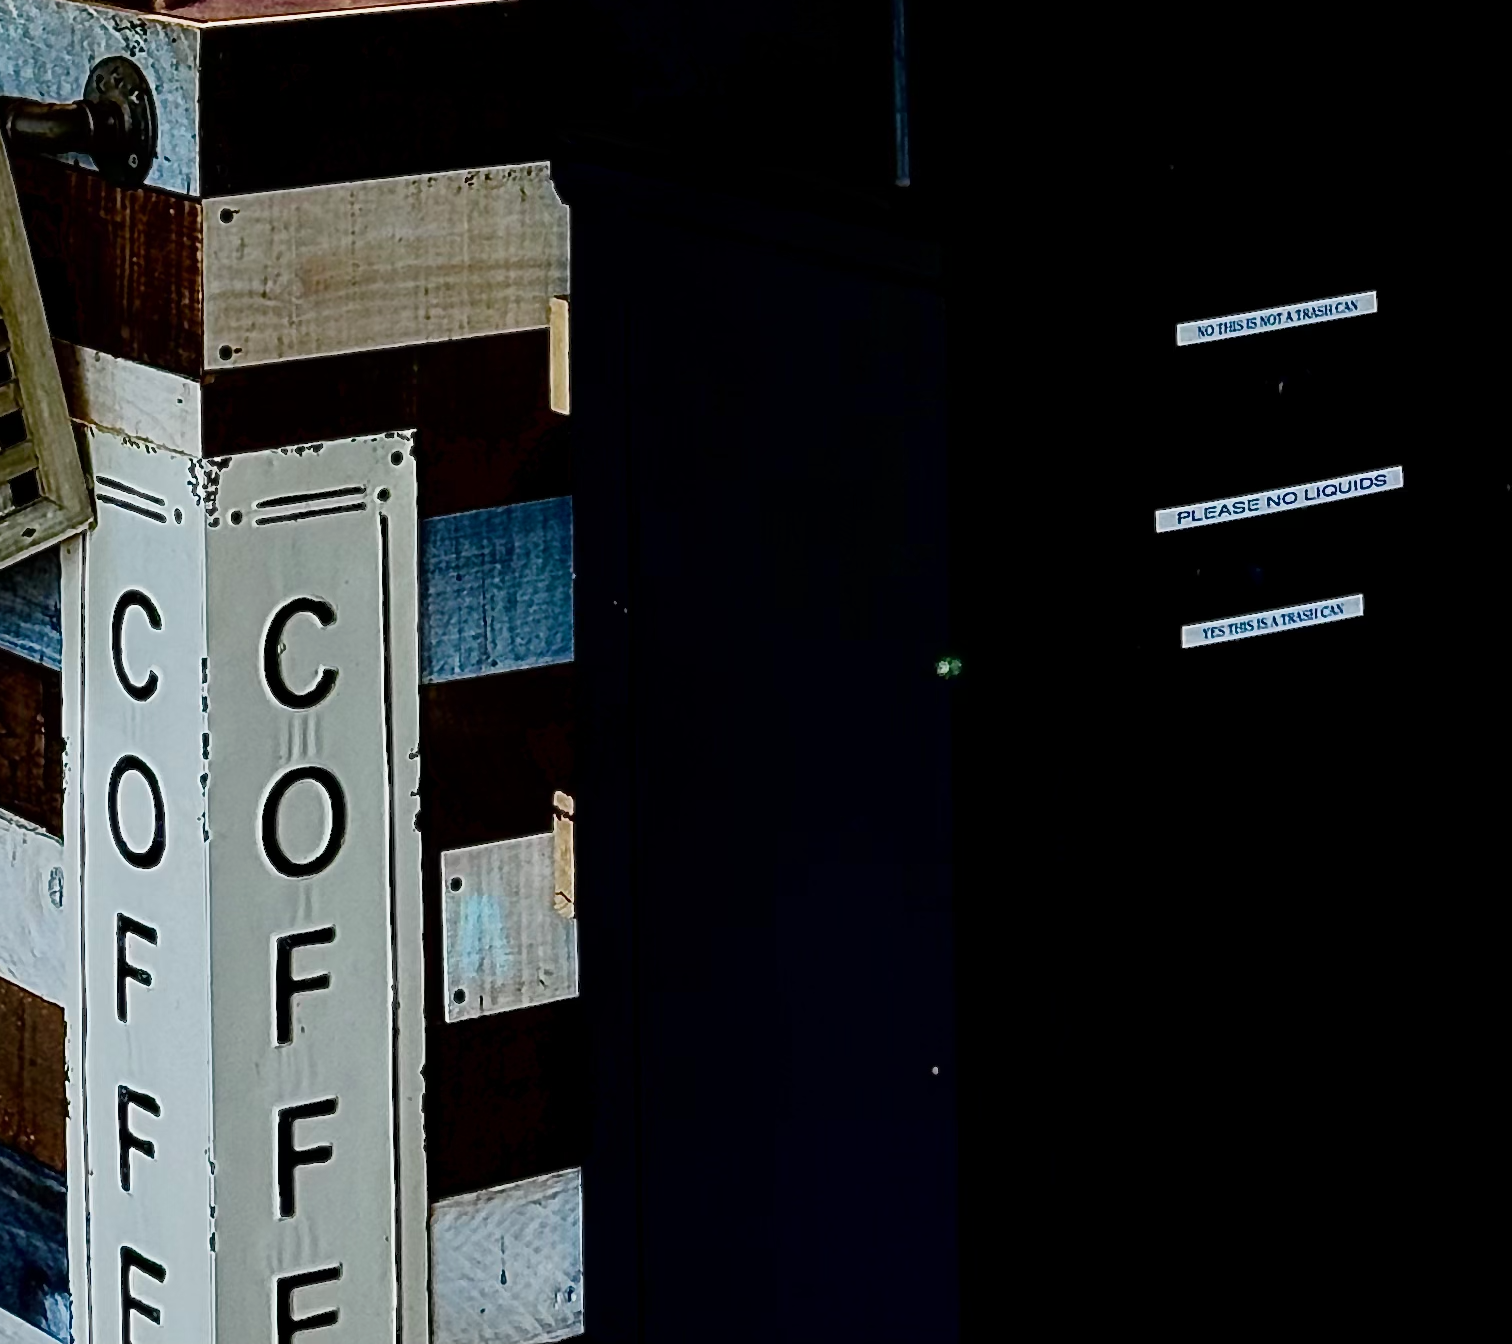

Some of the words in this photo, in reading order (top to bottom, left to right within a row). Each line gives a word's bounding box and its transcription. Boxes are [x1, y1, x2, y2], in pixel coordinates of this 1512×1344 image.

[1197, 324, 1215, 338] NO
[1217, 320, 1244, 334] THIS
[1246, 317, 1257, 331] IS
[1260, 311, 1285, 328] NOT
[1286, 309, 1294, 323] A
[1295, 303, 1333, 322] TRASH
[1335, 299, 1359, 315] CAN
[1177, 498, 1260, 525] PLEASE
[1266, 491, 1298, 508] NO
[1304, 473, 1388, 502] LIQUIDS
[1203, 625, 1226, 640] YES
[1228, 621, 1255, 635] THIS
[1257, 617, 1268, 630] IS
[1270, 615, 1279, 627] A
[1280, 608, 1319, 625] TRASH
[1320, 602, 1344, 617] CAN
